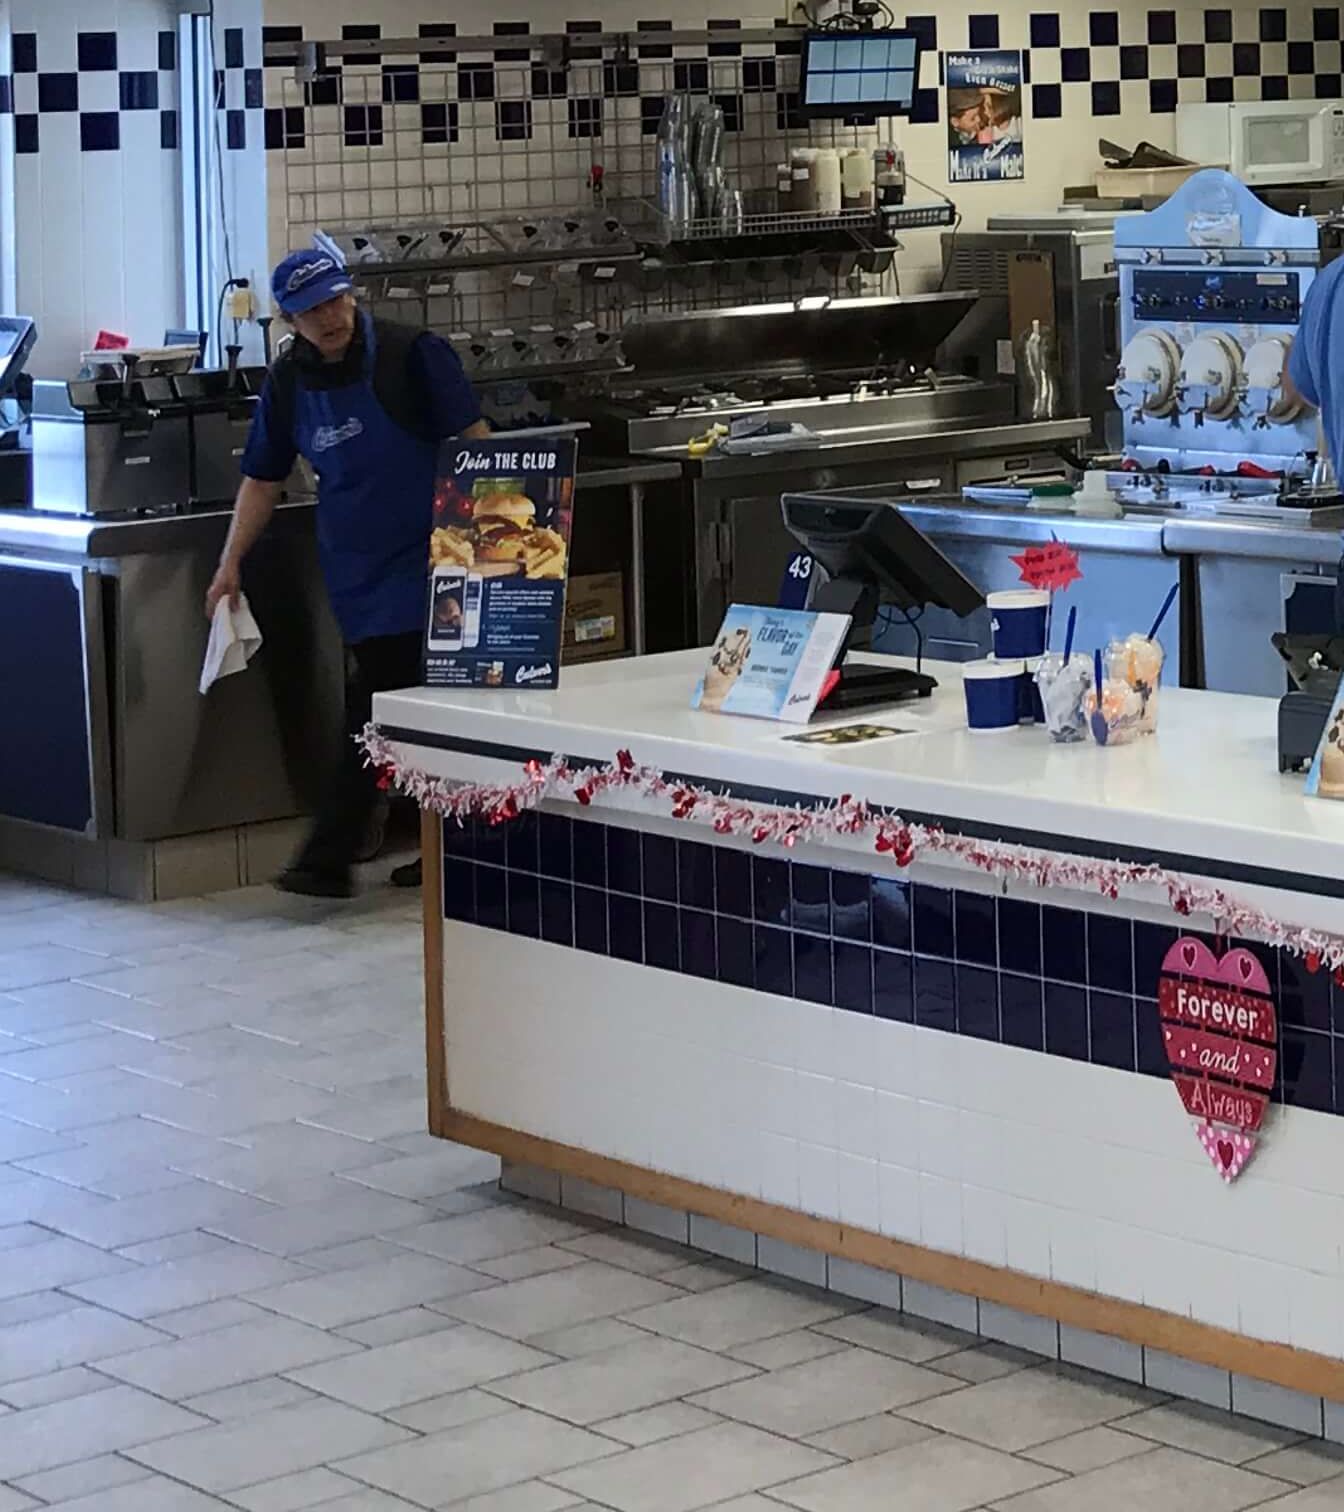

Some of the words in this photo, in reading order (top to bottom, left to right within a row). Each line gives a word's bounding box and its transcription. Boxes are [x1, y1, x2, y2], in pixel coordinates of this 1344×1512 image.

[948, 55, 972, 66] Make
[454, 450, 493, 474] Join
[494, 452, 518, 470] THE
[522, 452, 557, 470] CLUB
[788, 555, 813, 579] 43
[757, 625, 789, 643] FLAVOR
[515, 663, 552, 683] Culver's
[1177, 988, 1258, 1031] Forever
[1200, 1045, 1241, 1075] and
[1191, 1080, 1253, 1126] Always
